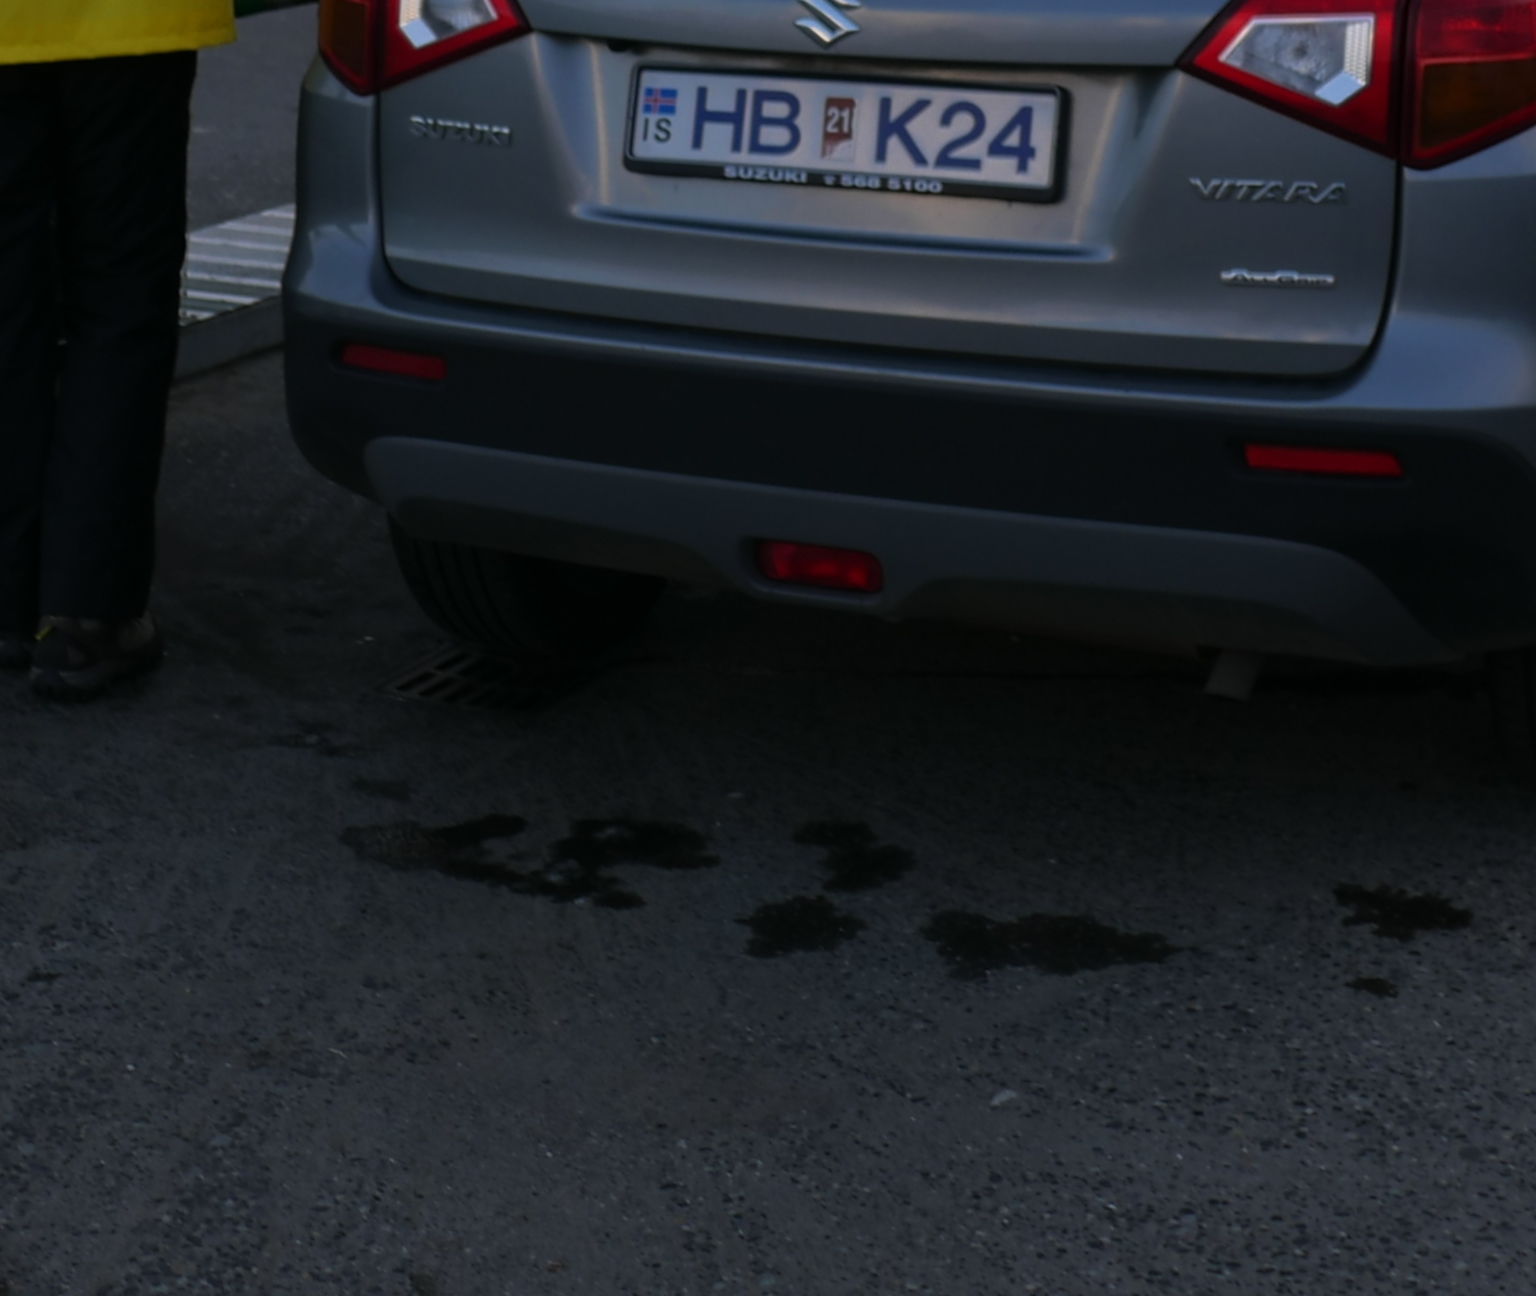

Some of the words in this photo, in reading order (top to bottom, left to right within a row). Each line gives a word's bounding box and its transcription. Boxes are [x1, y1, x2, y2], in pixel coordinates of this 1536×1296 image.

[643, 117, 673, 143] IS
[691, 86, 802, 156] HB
[874, 96, 1037, 174] K24
[825, 106, 852, 134] 21
[723, 163, 809, 185] SUZUKI
[1188, 176, 1347, 205] VITARA
